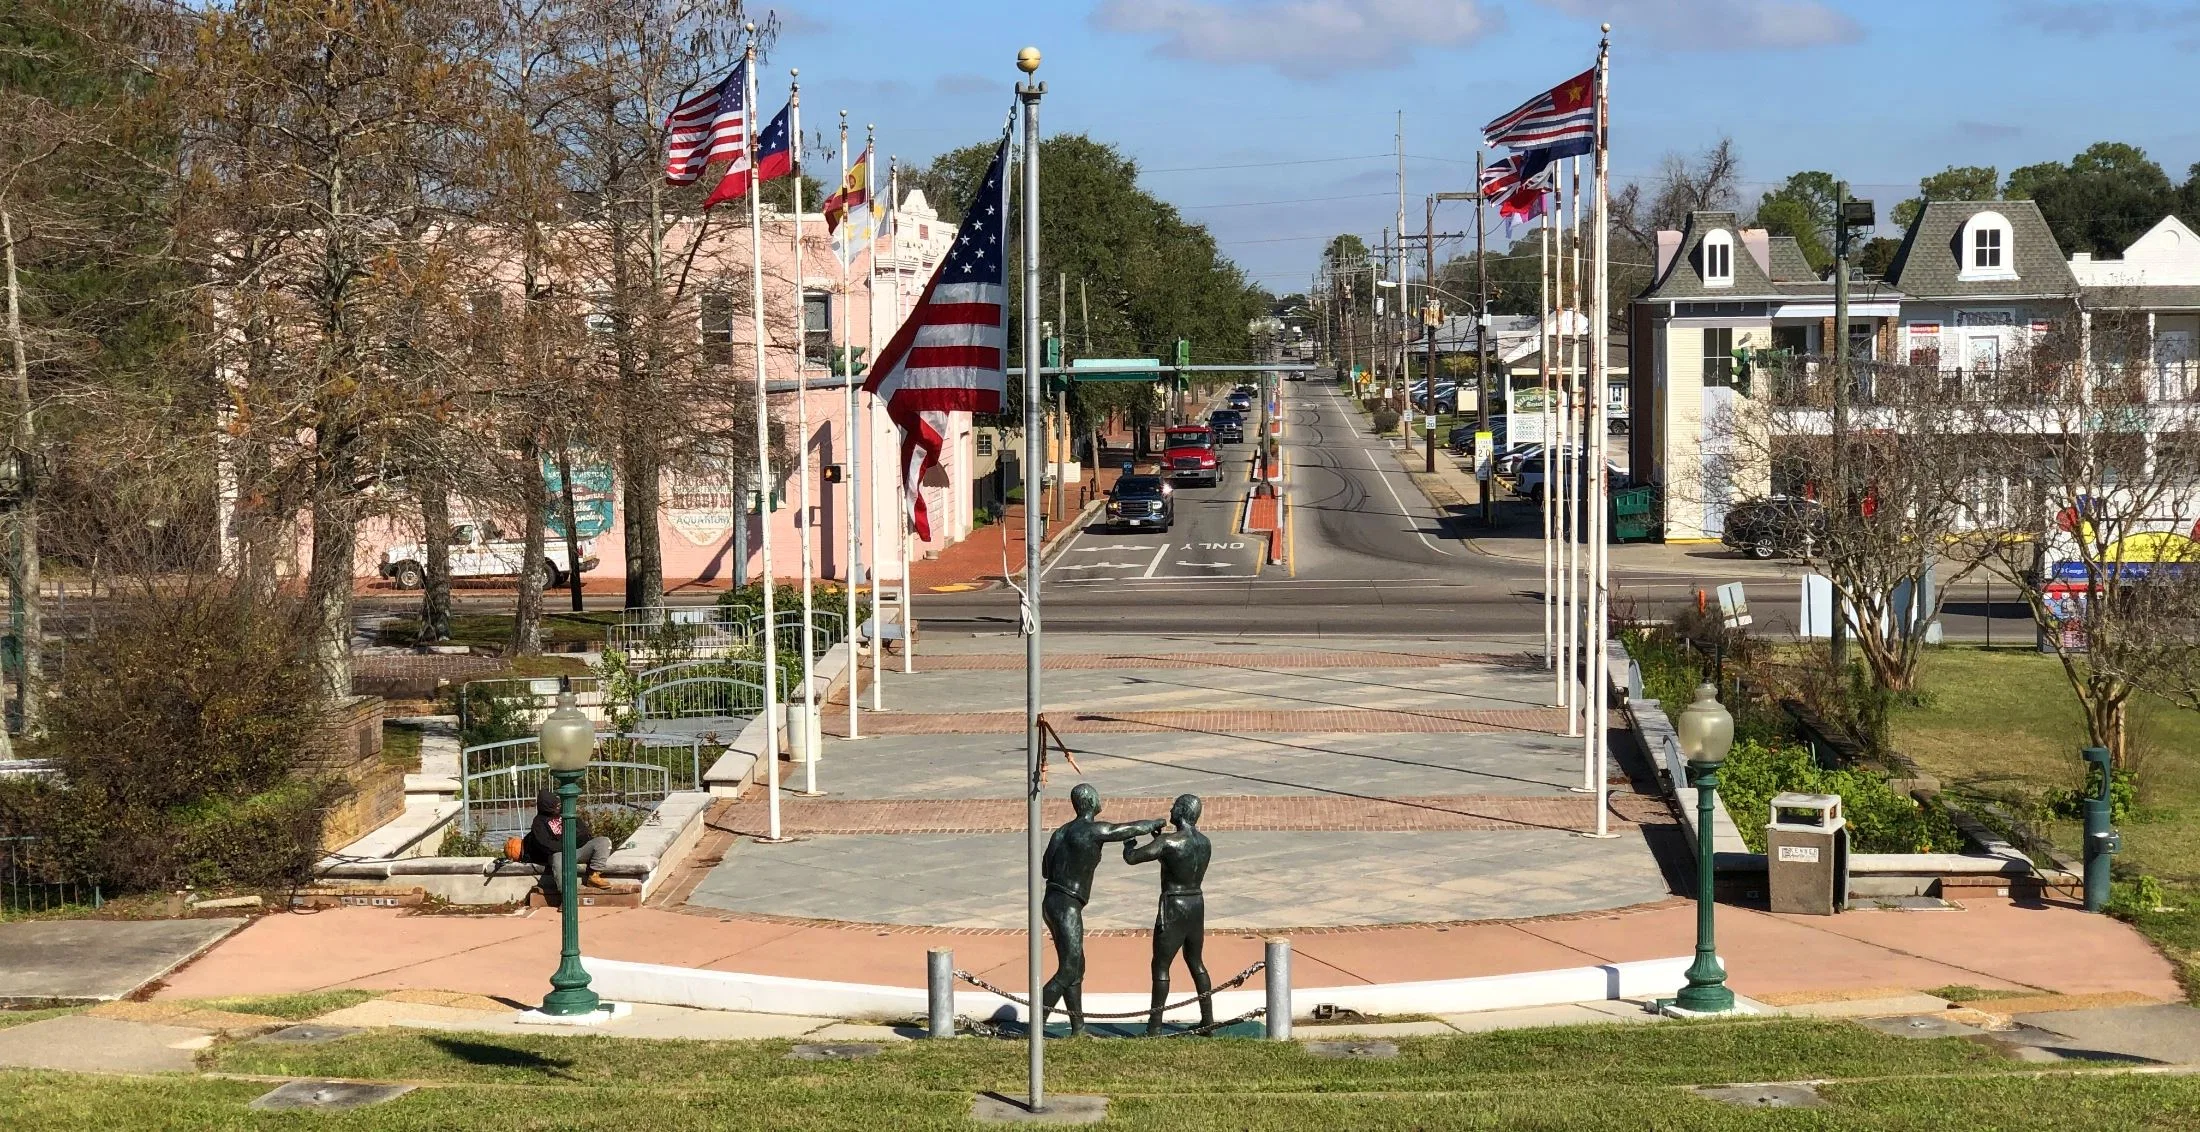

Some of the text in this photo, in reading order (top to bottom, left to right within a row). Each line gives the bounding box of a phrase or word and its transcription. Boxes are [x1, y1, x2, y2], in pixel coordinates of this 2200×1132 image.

[1478, 449, 1490, 457] 20
[676, 515, 729, 525] AQUARIUM
[1180, 542, 1244, 550] ONLY
